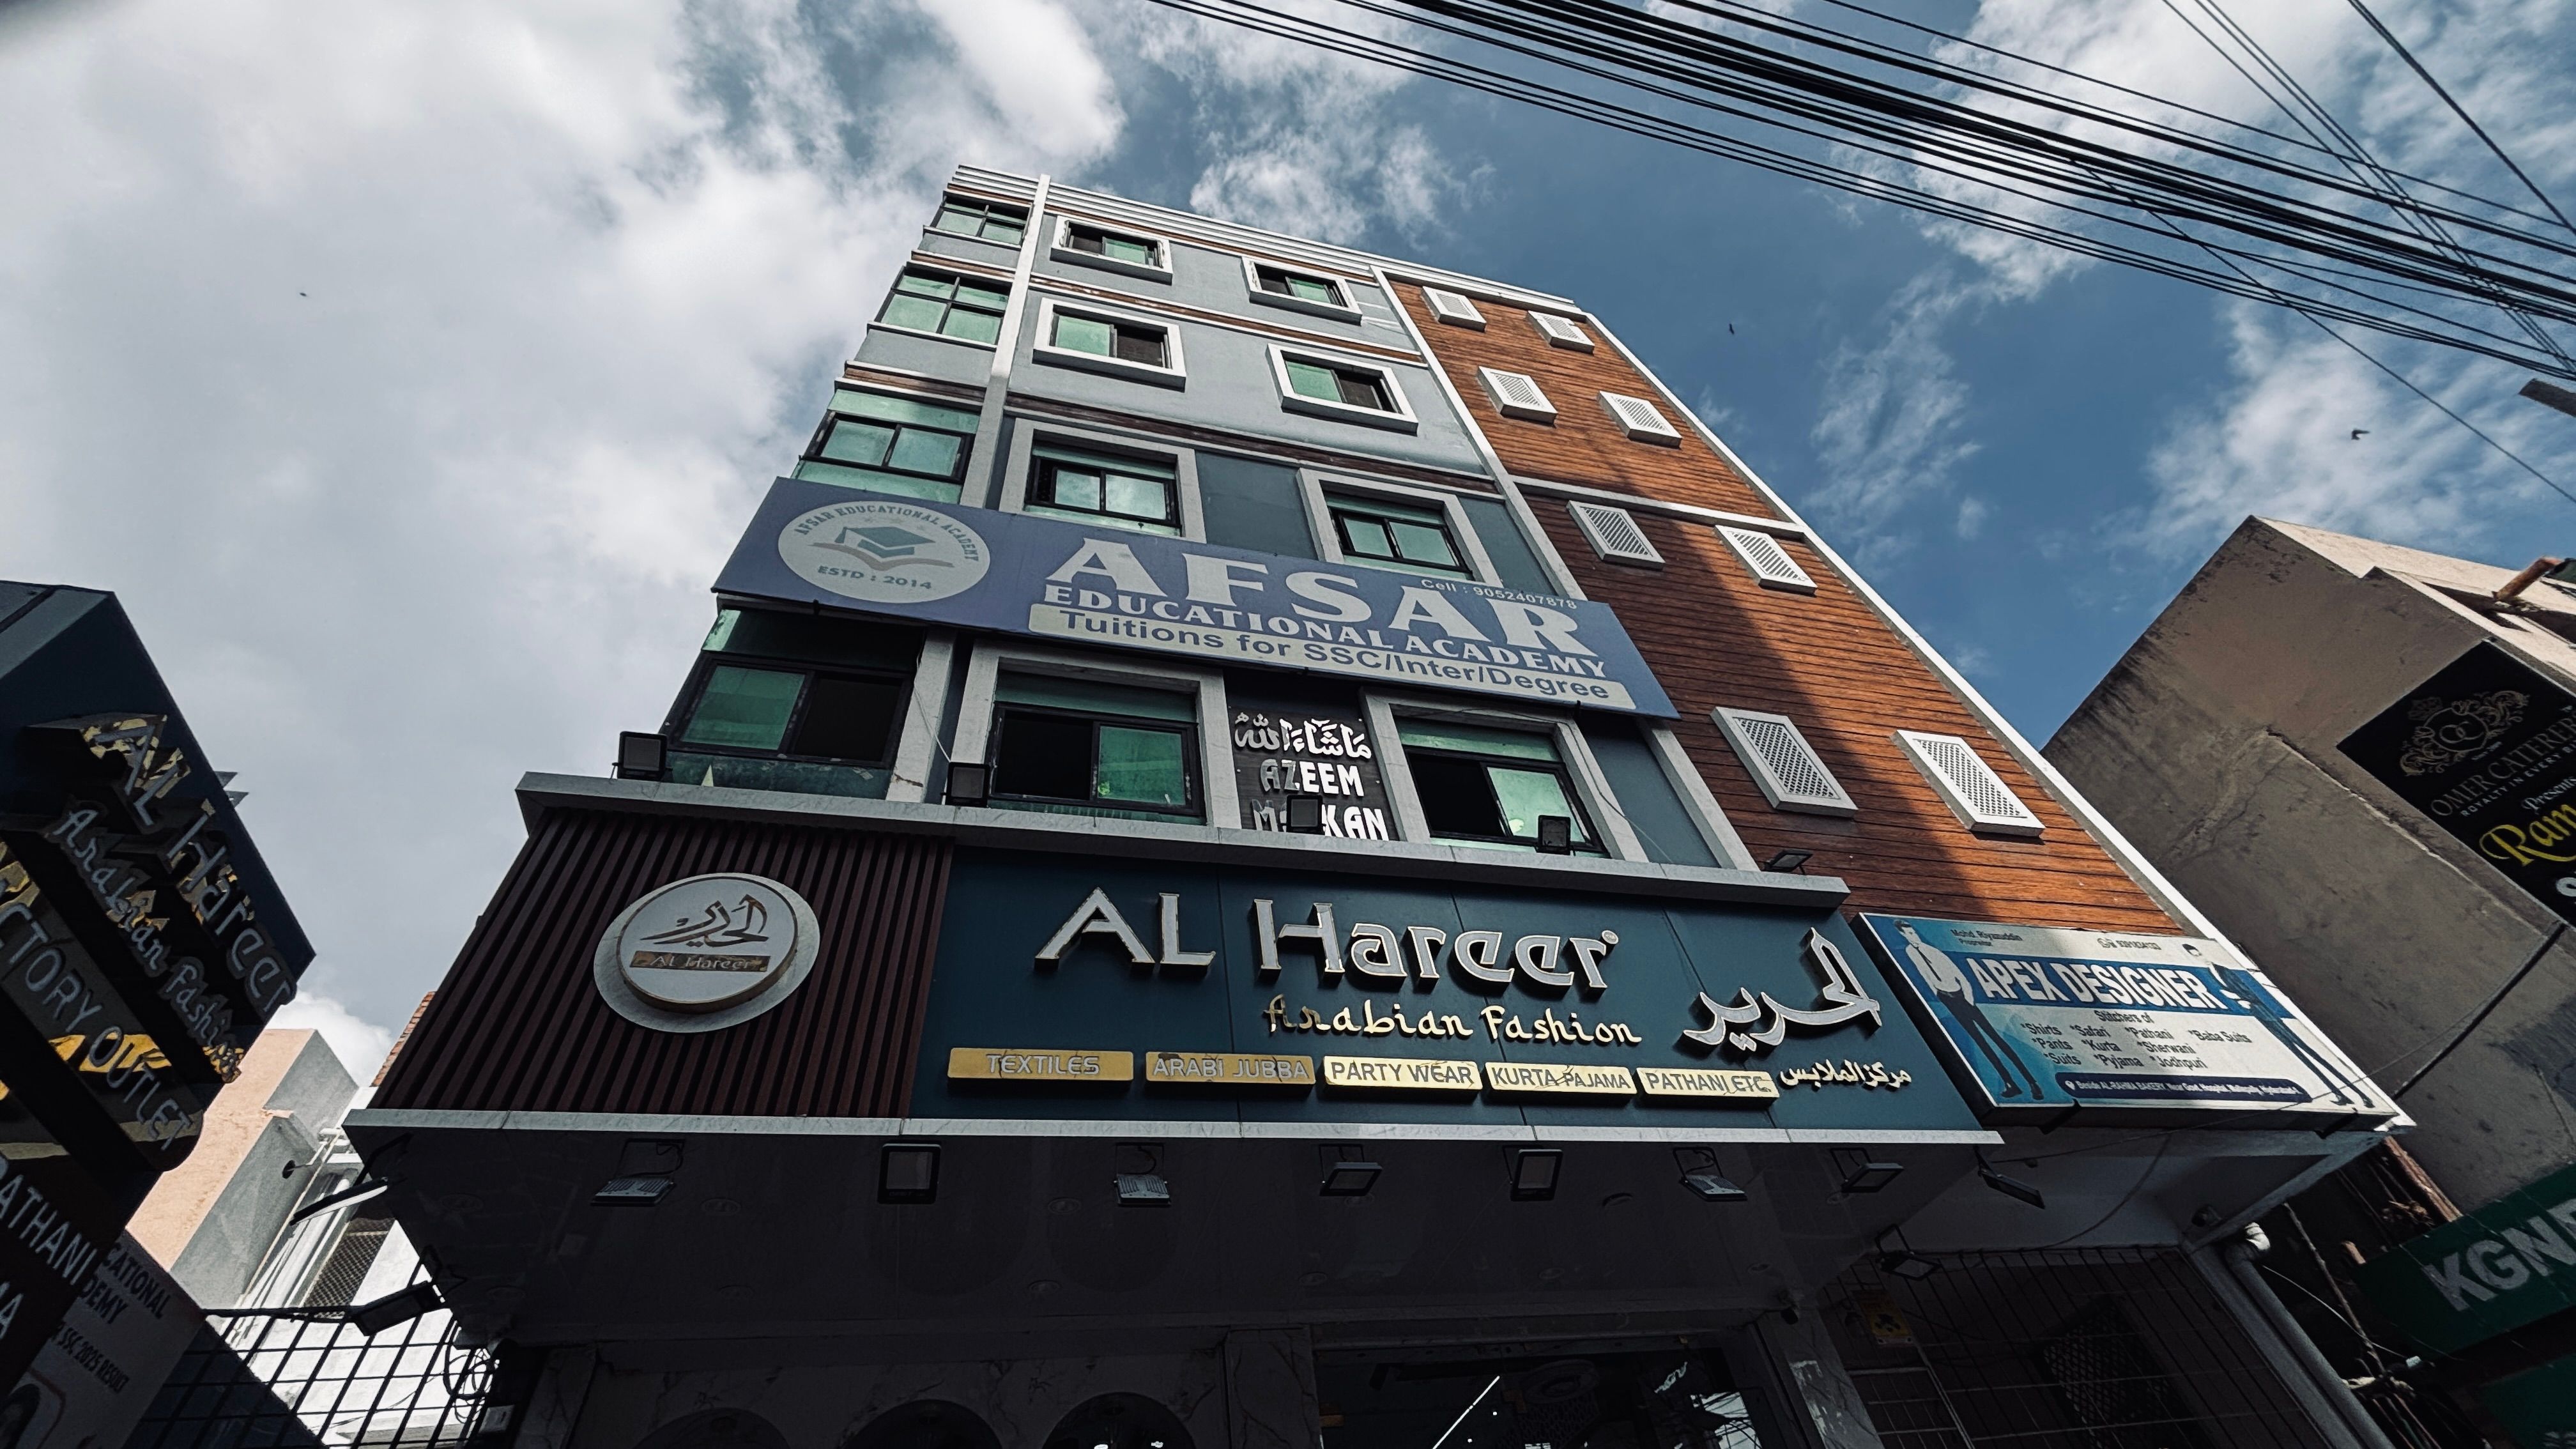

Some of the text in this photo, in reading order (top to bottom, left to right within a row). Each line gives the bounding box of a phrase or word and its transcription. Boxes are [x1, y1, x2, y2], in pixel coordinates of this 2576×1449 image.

[794, 505, 979, 562] AFSAR EDUCATIONAL ACADEMY
[818, 565, 864, 579] ESTD
[883, 576, 932, 589] 2014
[1045, 537, 1598, 657] AFSAR
[1421, 579, 1457, 593] Cell
[1473, 586, 1577, 610] 9052407878
[1044, 584, 1606, 677] EDUCATIONAL ACADEMY
[1060, 610, 1609, 699] Tuitions for SSC/Inter/Degree
[1261, 758, 1365, 797] AZEEM
[2430, 709, 2576, 816] OMER CATERER
[2460, 785, 2509, 817] ROYALTY
[2508, 776, 2524, 788] IN
[2524, 753, 2562, 778] EVERY
[1252, 799, 1390, 841] MKAN
[1035, 887, 1607, 988] AL Hareer
[686, 956, 752, 970] Hareer
[1967, 958, 2228, 1010] APEX DESIGNER
[1683, 927, 1883, 1052] الحرير
[0, 902, 194, 1151] CTORY OUTLET
[1263, 993, 1643, 1045] Arabian Fashion
[2094, 1010, 2155, 1023] Stitchers of
[986, 1053, 1100, 1076] TEXTILES
[1153, 1057, 1310, 1080] ARABI JUBBA
[1331, 1062, 1475, 1085] PARTY WEAR
[1491, 1068, 1630, 1089] KURTA PAJAMA
[1646, 1073, 1729, 1093] PATHANI
